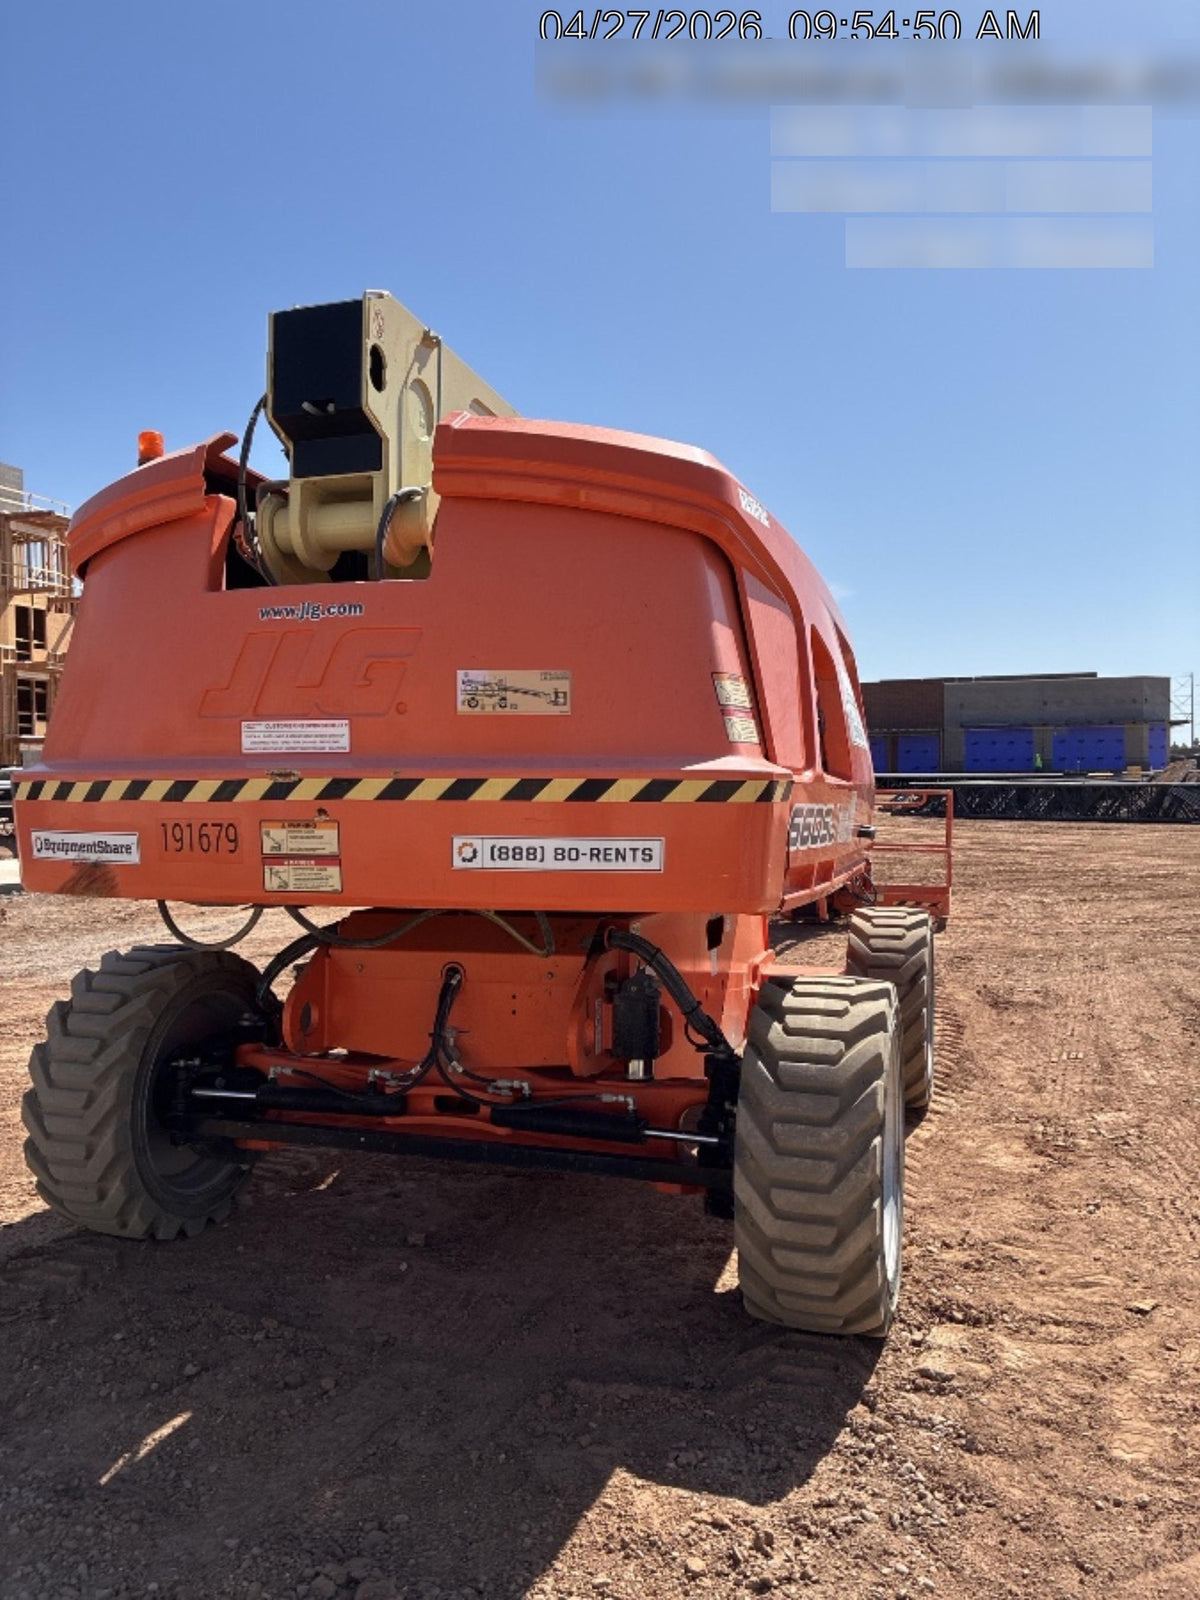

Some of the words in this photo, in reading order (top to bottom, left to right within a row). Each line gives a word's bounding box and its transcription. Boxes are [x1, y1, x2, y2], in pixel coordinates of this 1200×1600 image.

[259, 602, 363, 620] www.jlg.com
[199, 627, 423, 718] JLG
[43, 838, 134, 856] EquipmentShare
[161, 822, 239, 854] 191679
[490, 844, 545, 863] (888)
